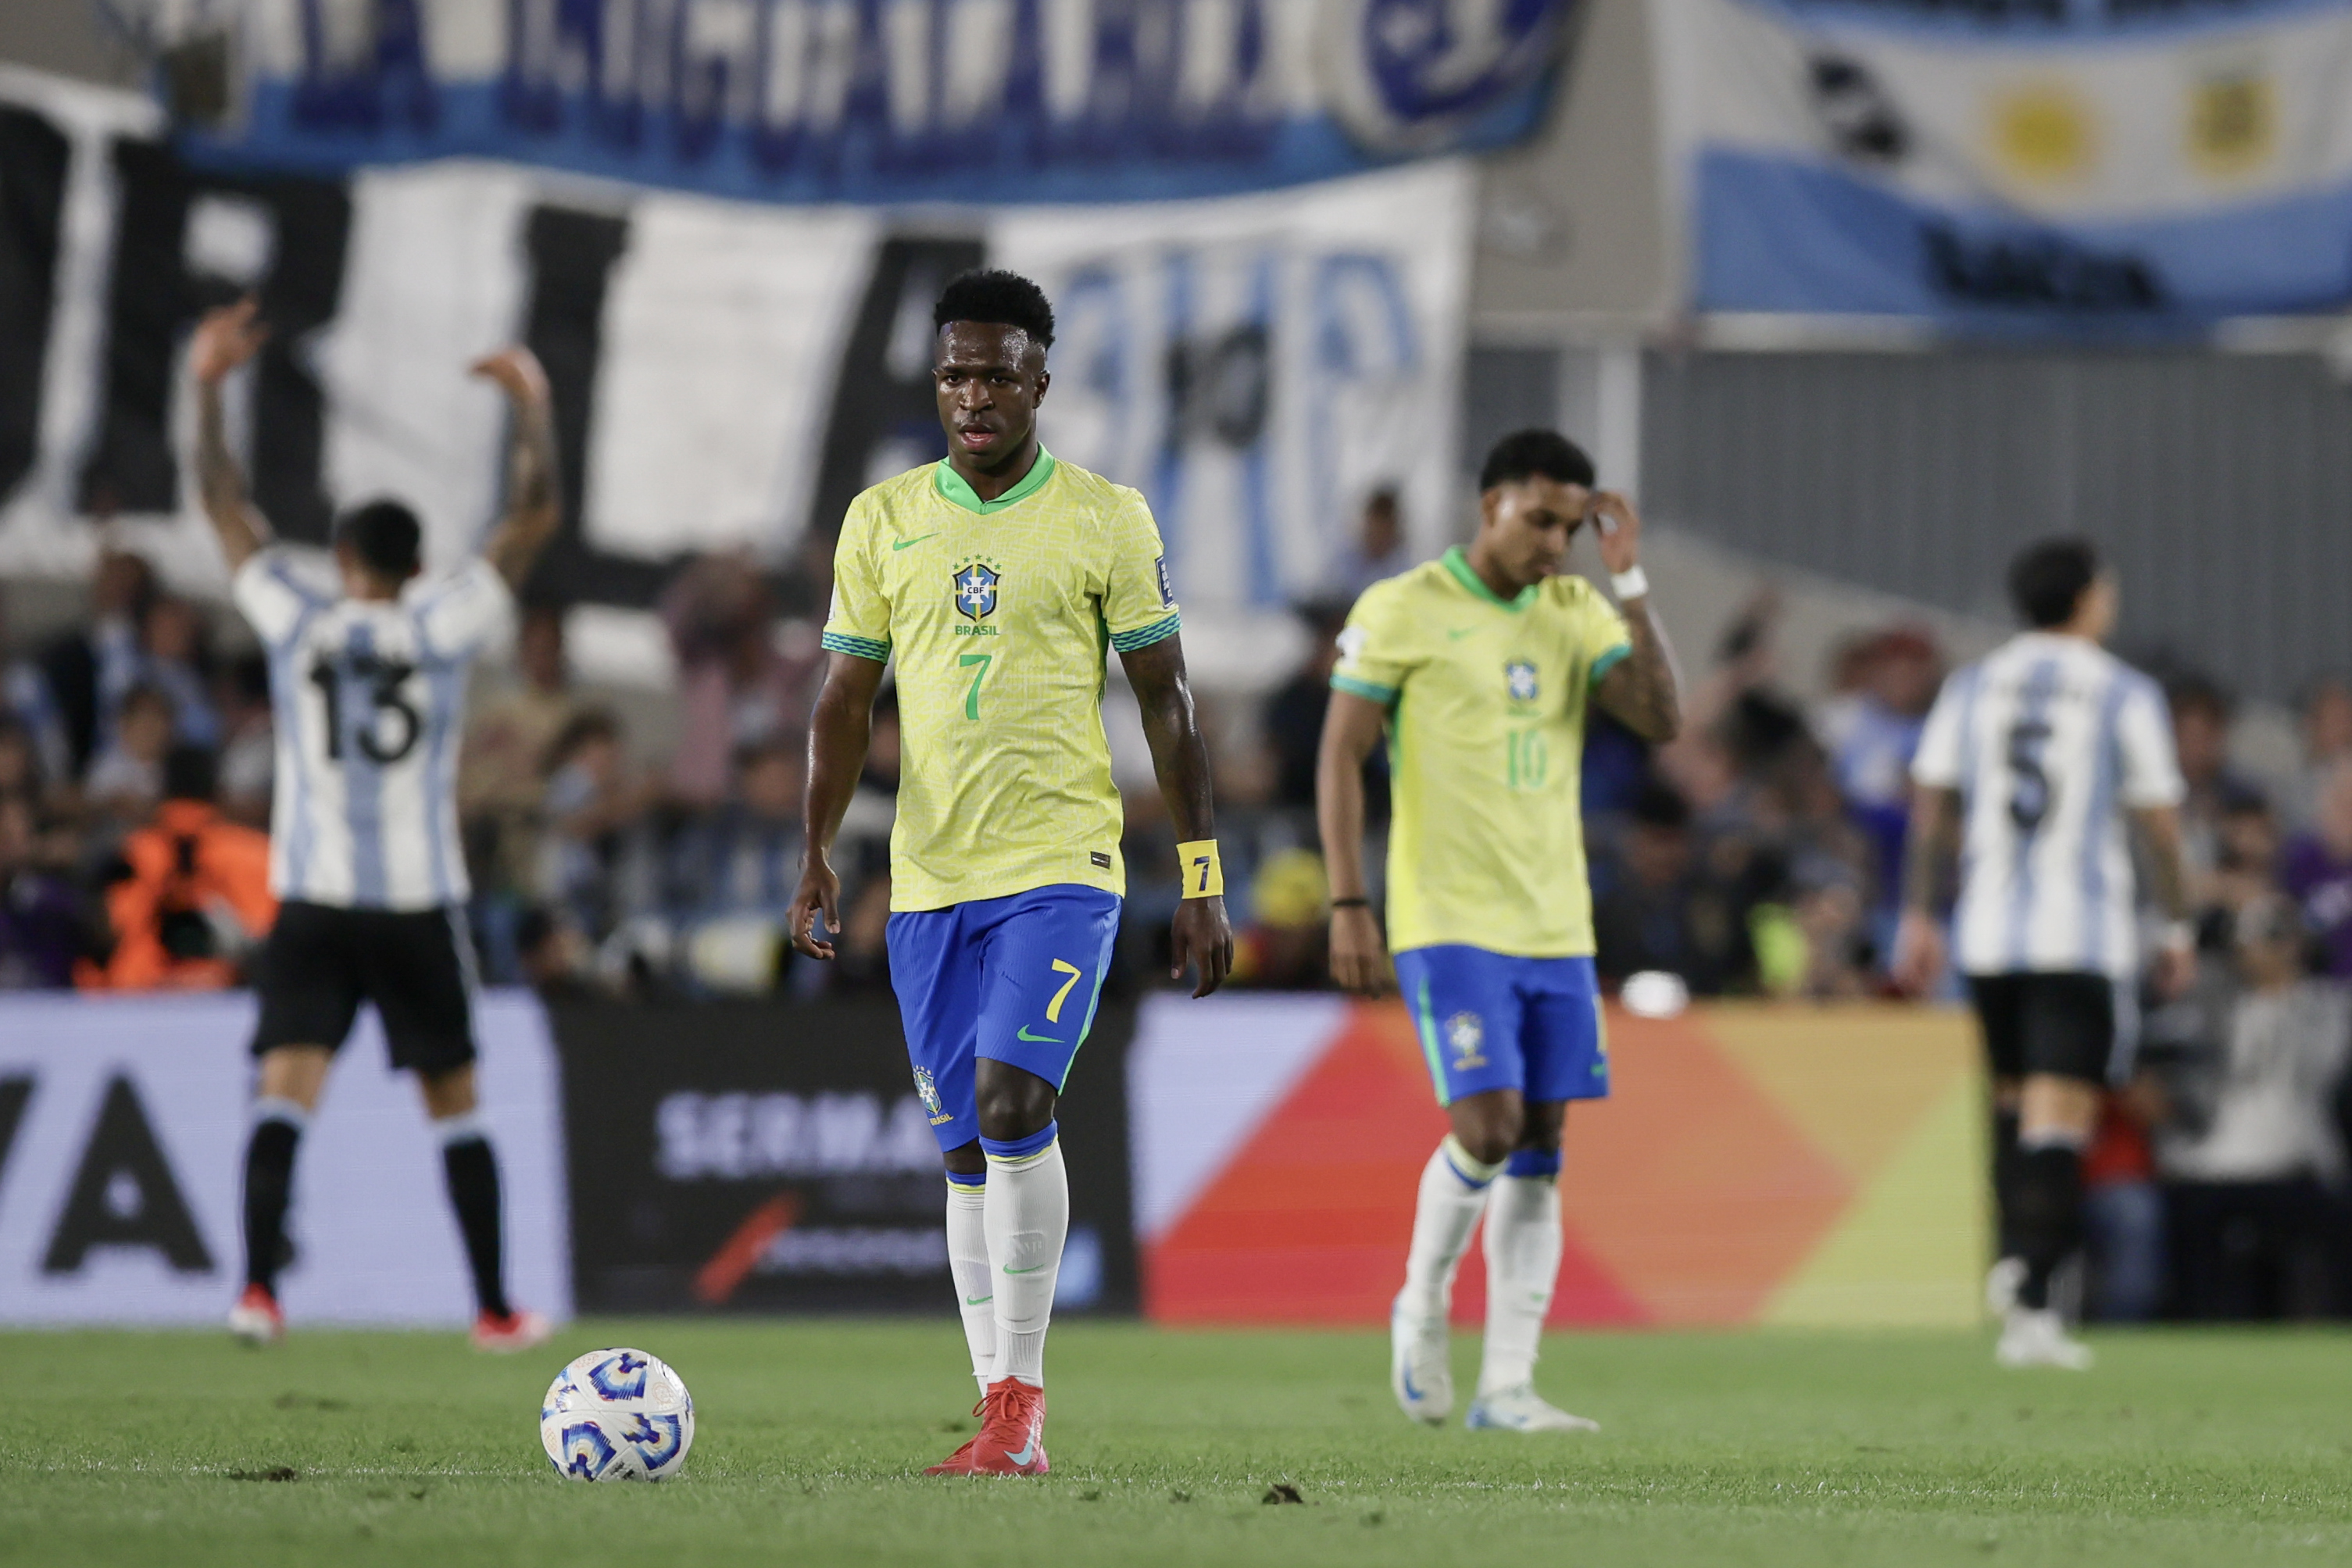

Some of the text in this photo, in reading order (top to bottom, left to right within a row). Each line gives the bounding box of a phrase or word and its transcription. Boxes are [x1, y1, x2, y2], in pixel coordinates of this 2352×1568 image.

[955, 625, 1000, 636] BRASIL
[309, 655, 420, 763] 13
[960, 654, 992, 720] 7
[1508, 730, 1548, 788] 10
[2003, 719, 2056, 832] 5
[1193, 855, 1210, 891] 7
[1046, 958, 1081, 1023] 7
